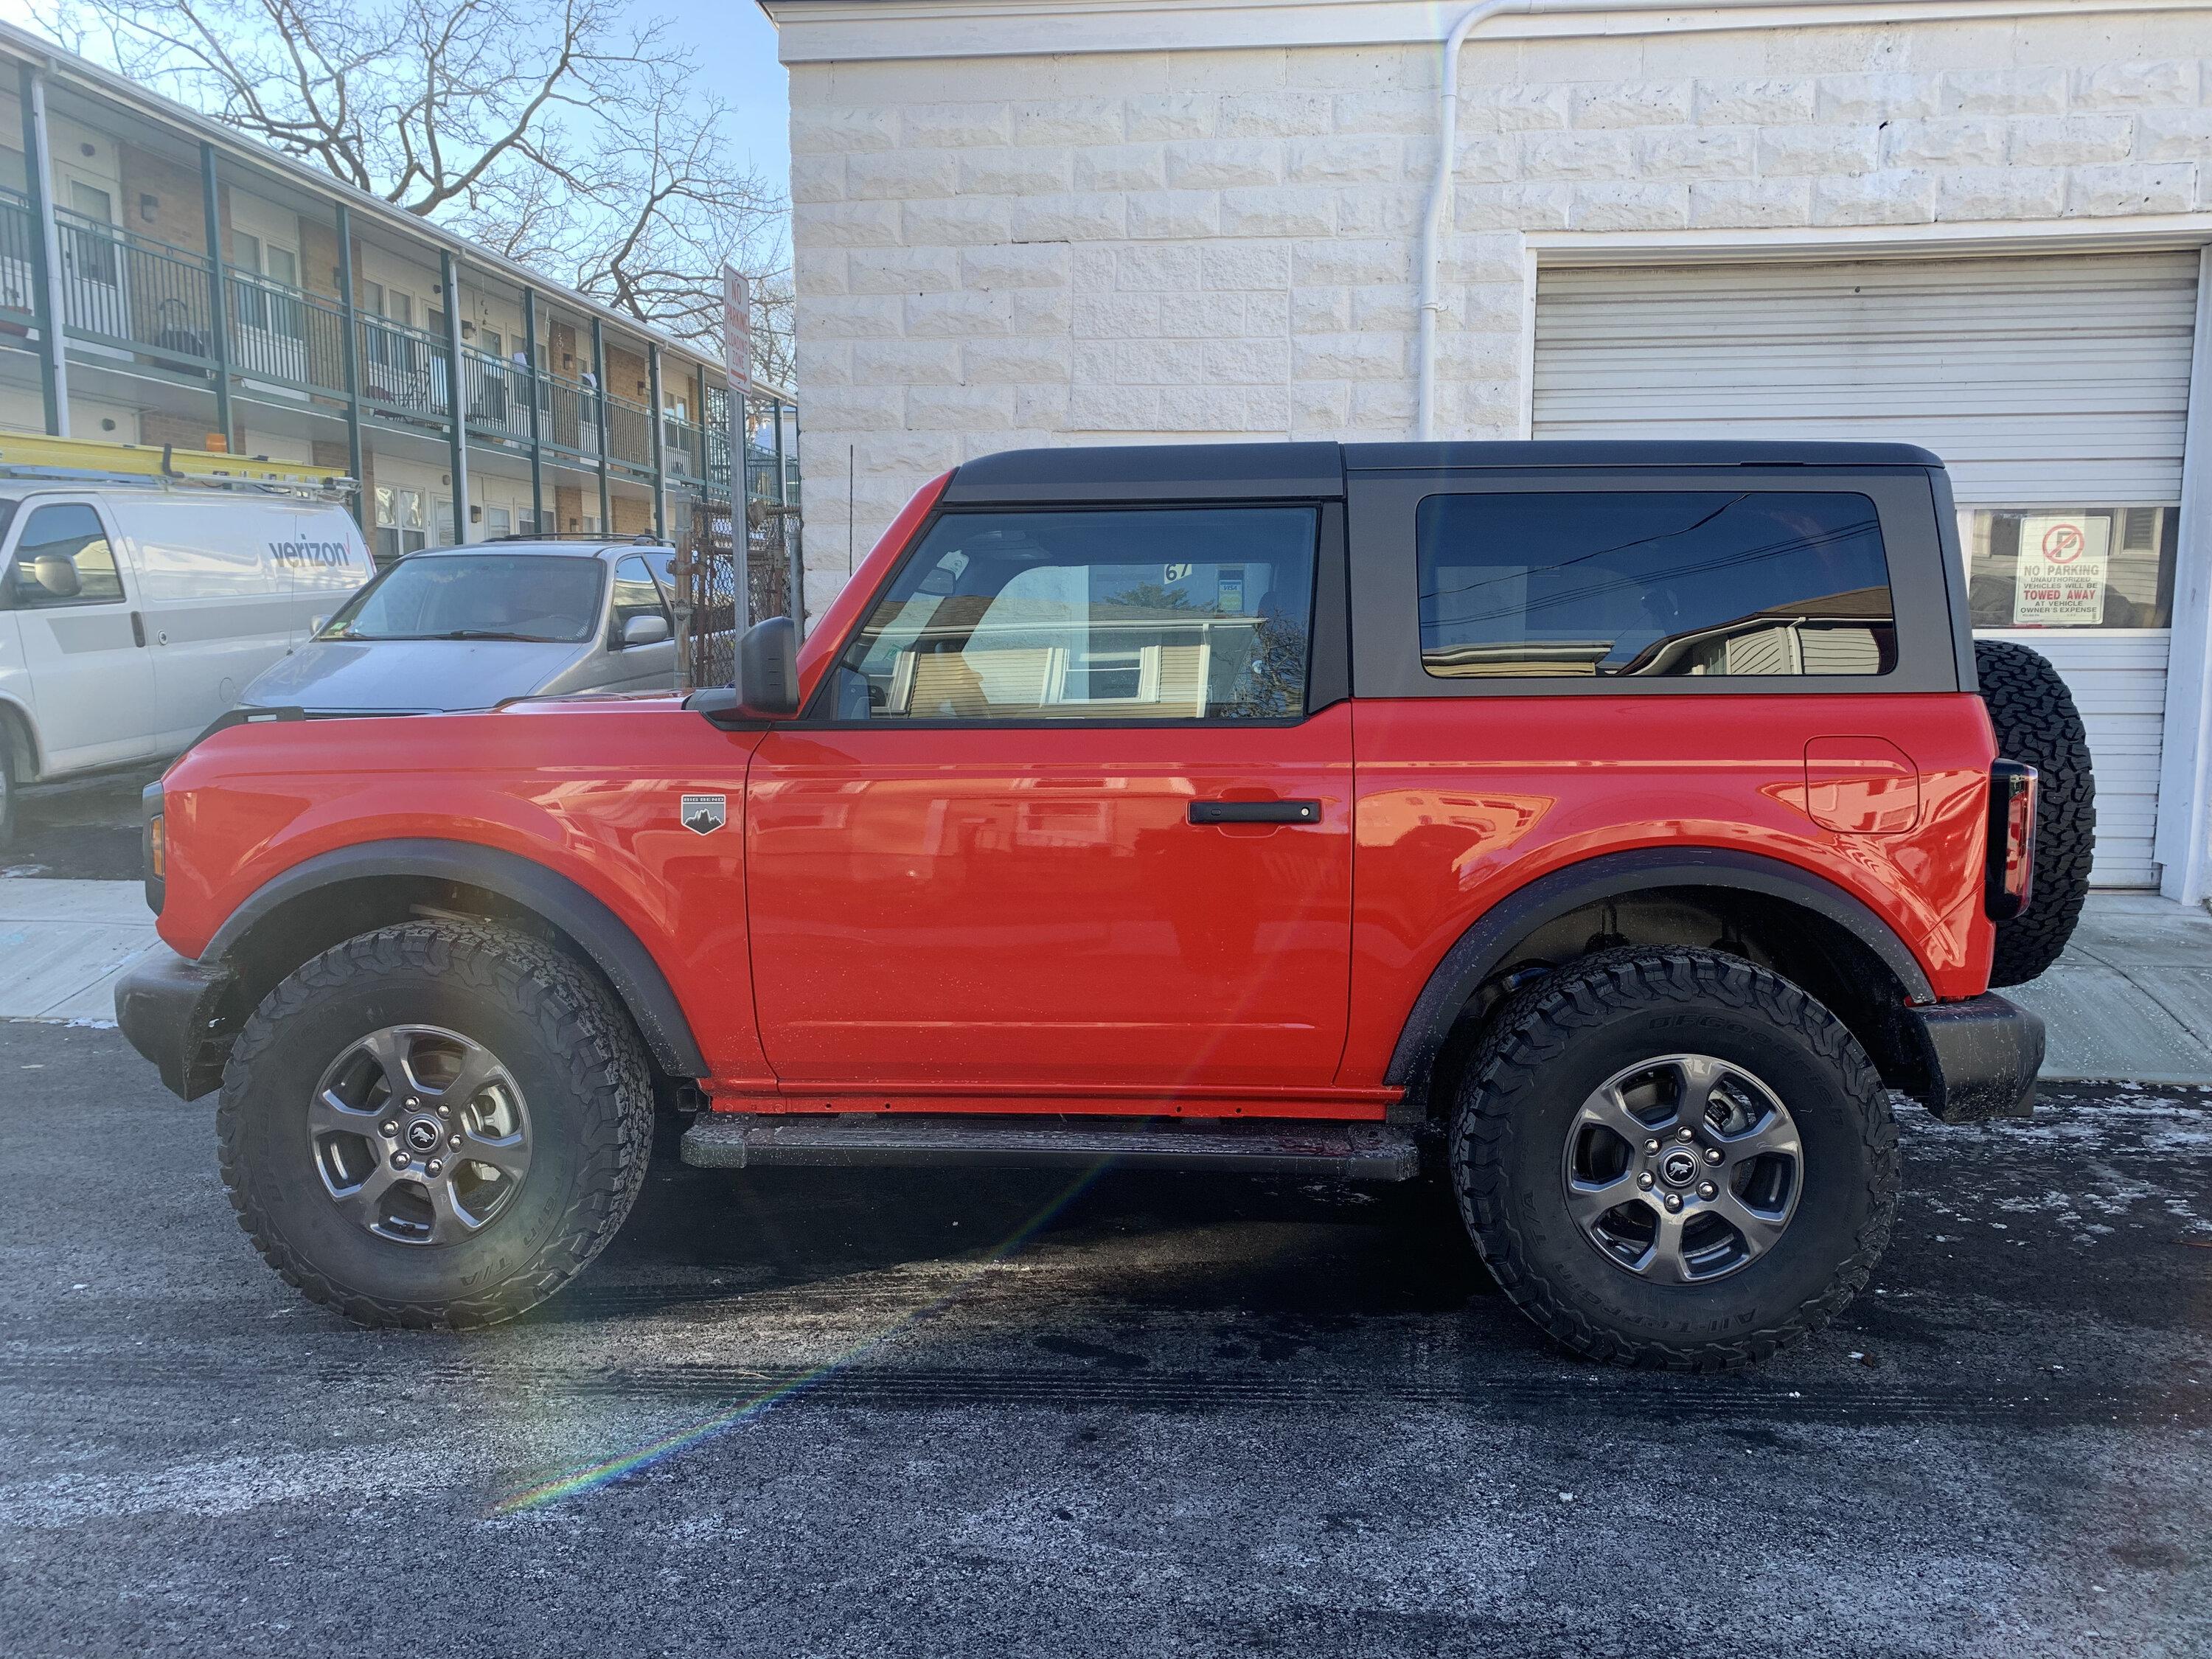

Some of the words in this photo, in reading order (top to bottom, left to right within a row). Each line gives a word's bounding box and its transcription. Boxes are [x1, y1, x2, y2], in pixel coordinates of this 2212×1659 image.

[731, 279, 741, 305] NO
[727, 303, 748, 335] PARKING
[728, 332, 748, 355] LOADING
[732, 350, 745, 369] ZONE
[268, 533, 349, 567] verizon
[2024, 566, 2040, 576] NO
[2048, 565, 2099, 576] PARKING
[2023, 591, 2061, 600] TOWED
[2067, 590, 2096, 600] AWAY
